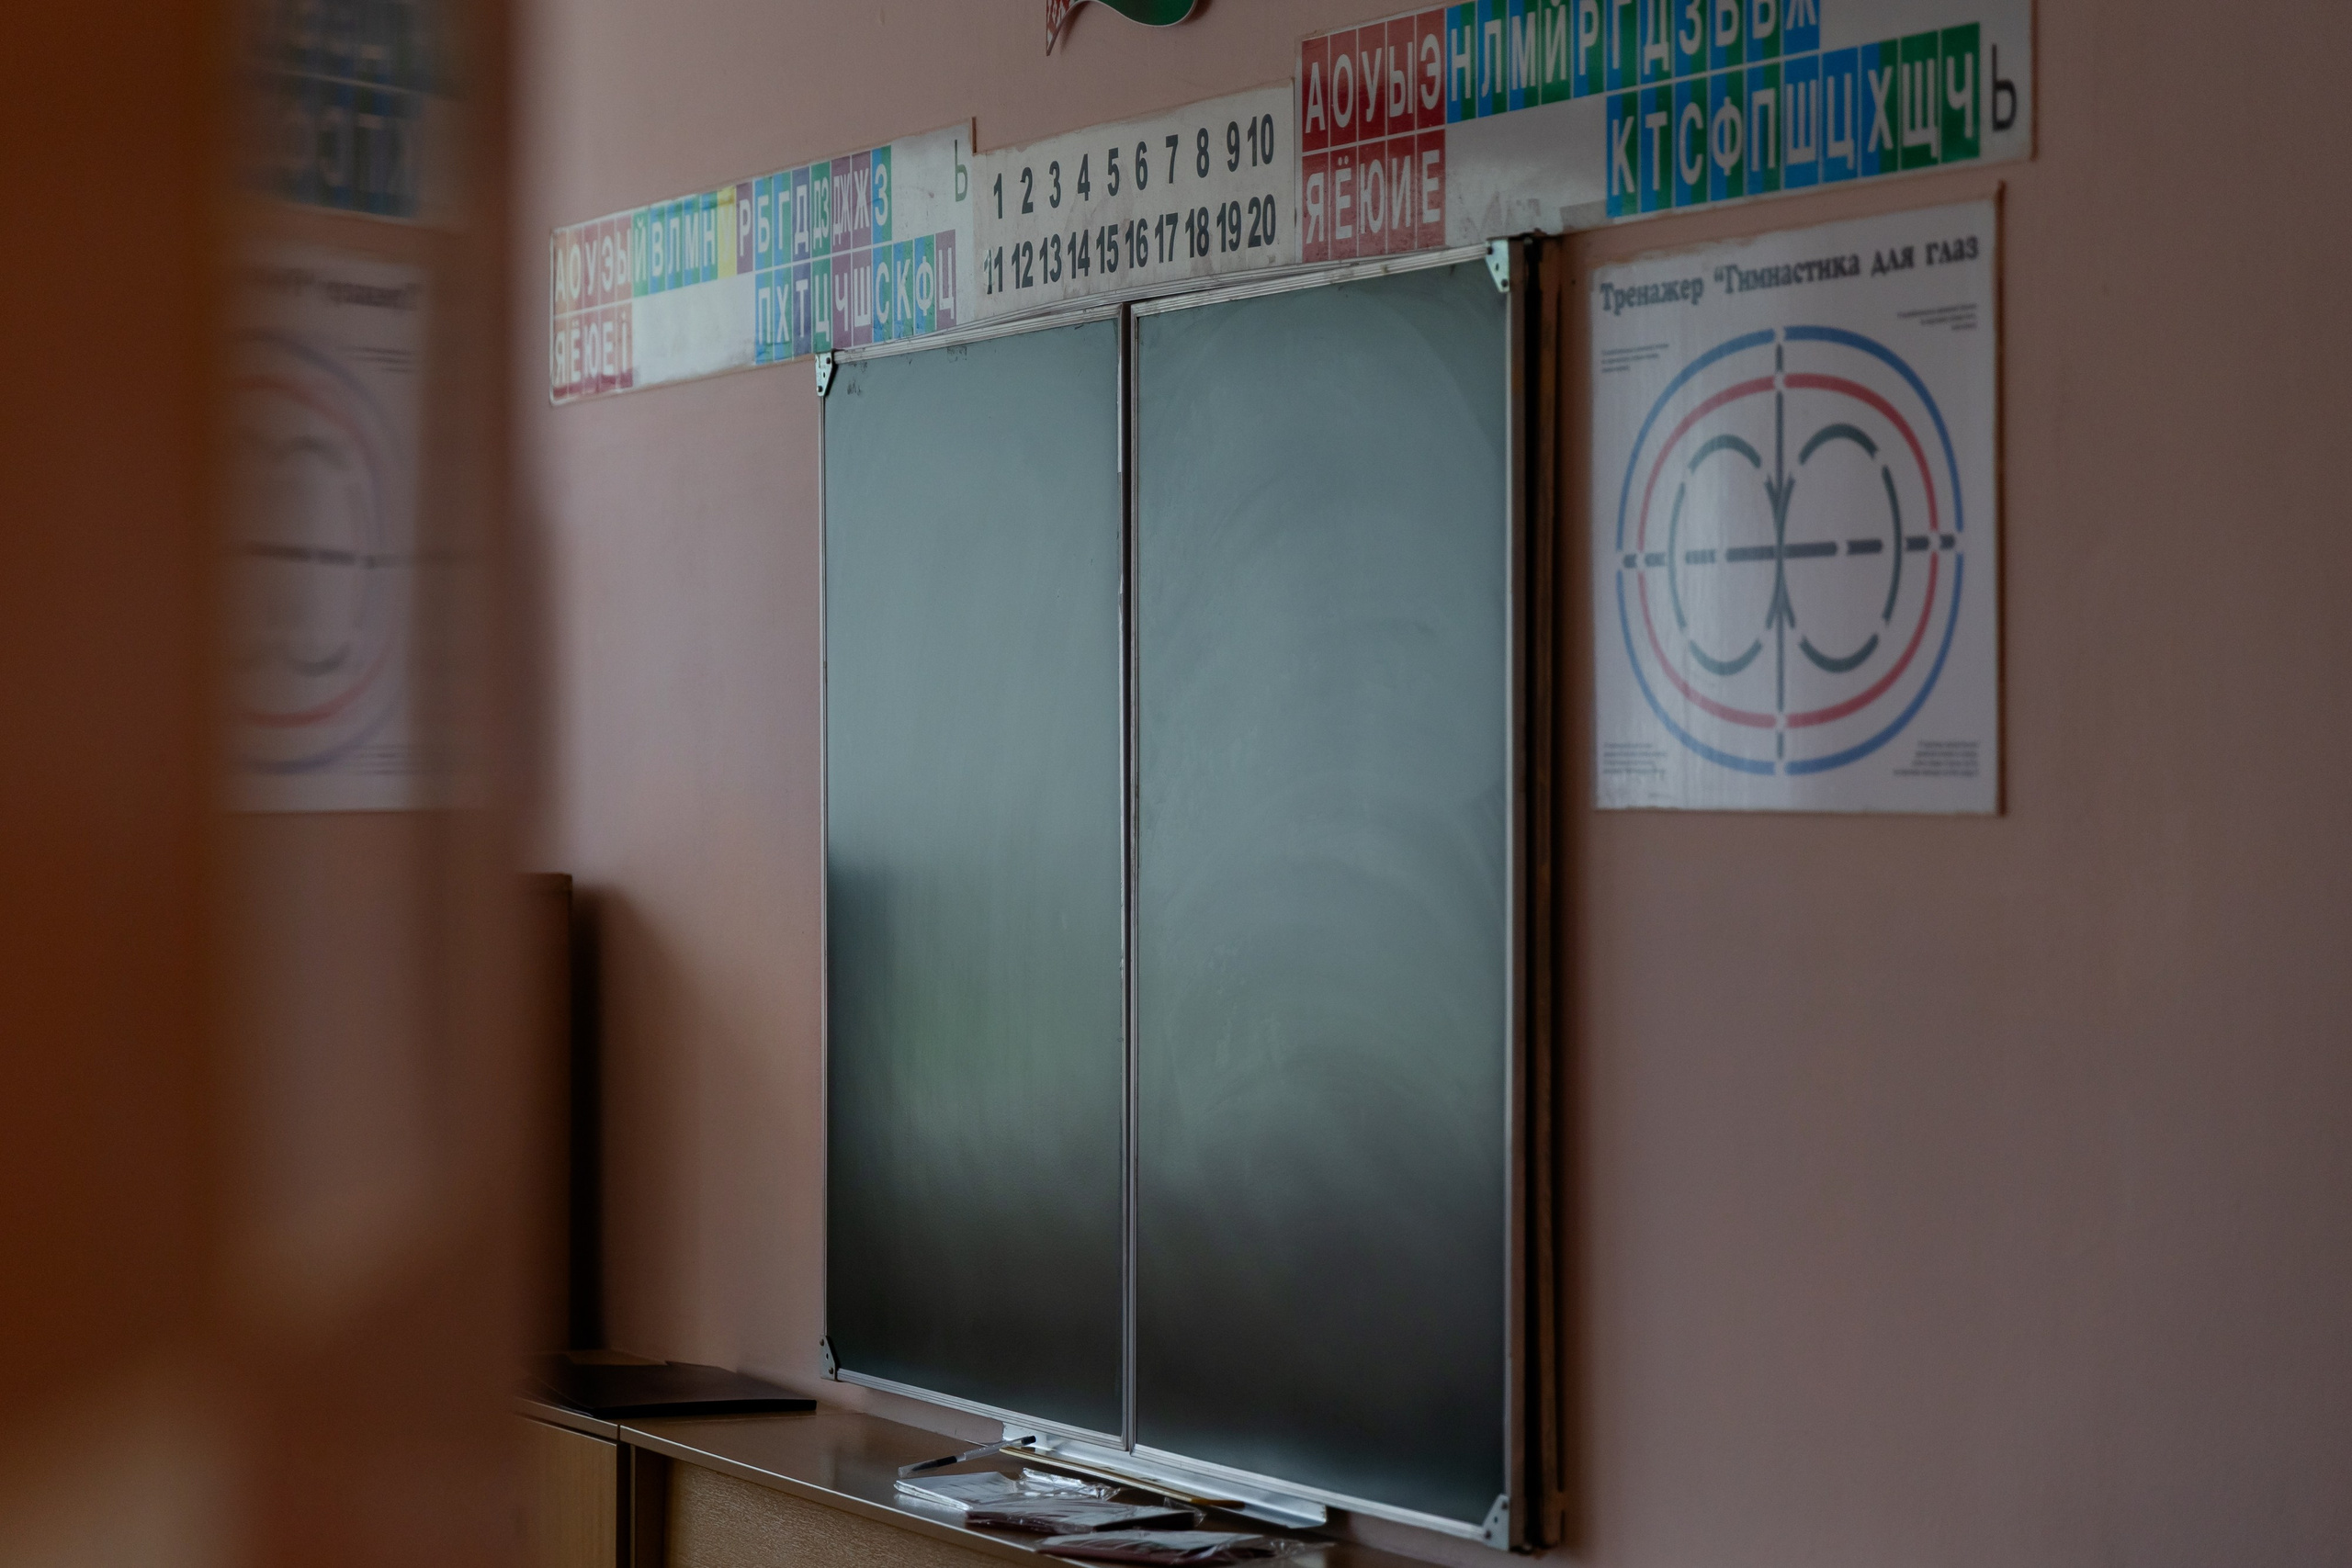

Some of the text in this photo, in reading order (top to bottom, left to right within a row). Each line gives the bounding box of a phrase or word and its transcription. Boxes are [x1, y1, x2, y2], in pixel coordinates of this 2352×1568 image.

[994, 113, 1274, 220] 1 2 3 4 5 6 7 8 9 10
[983, 194, 1276, 295] 11 12 13 14 15 16 17 18 19 20
[1600, 276, 1704, 315] Тренажер
[1871, 244, 1915, 277] для
